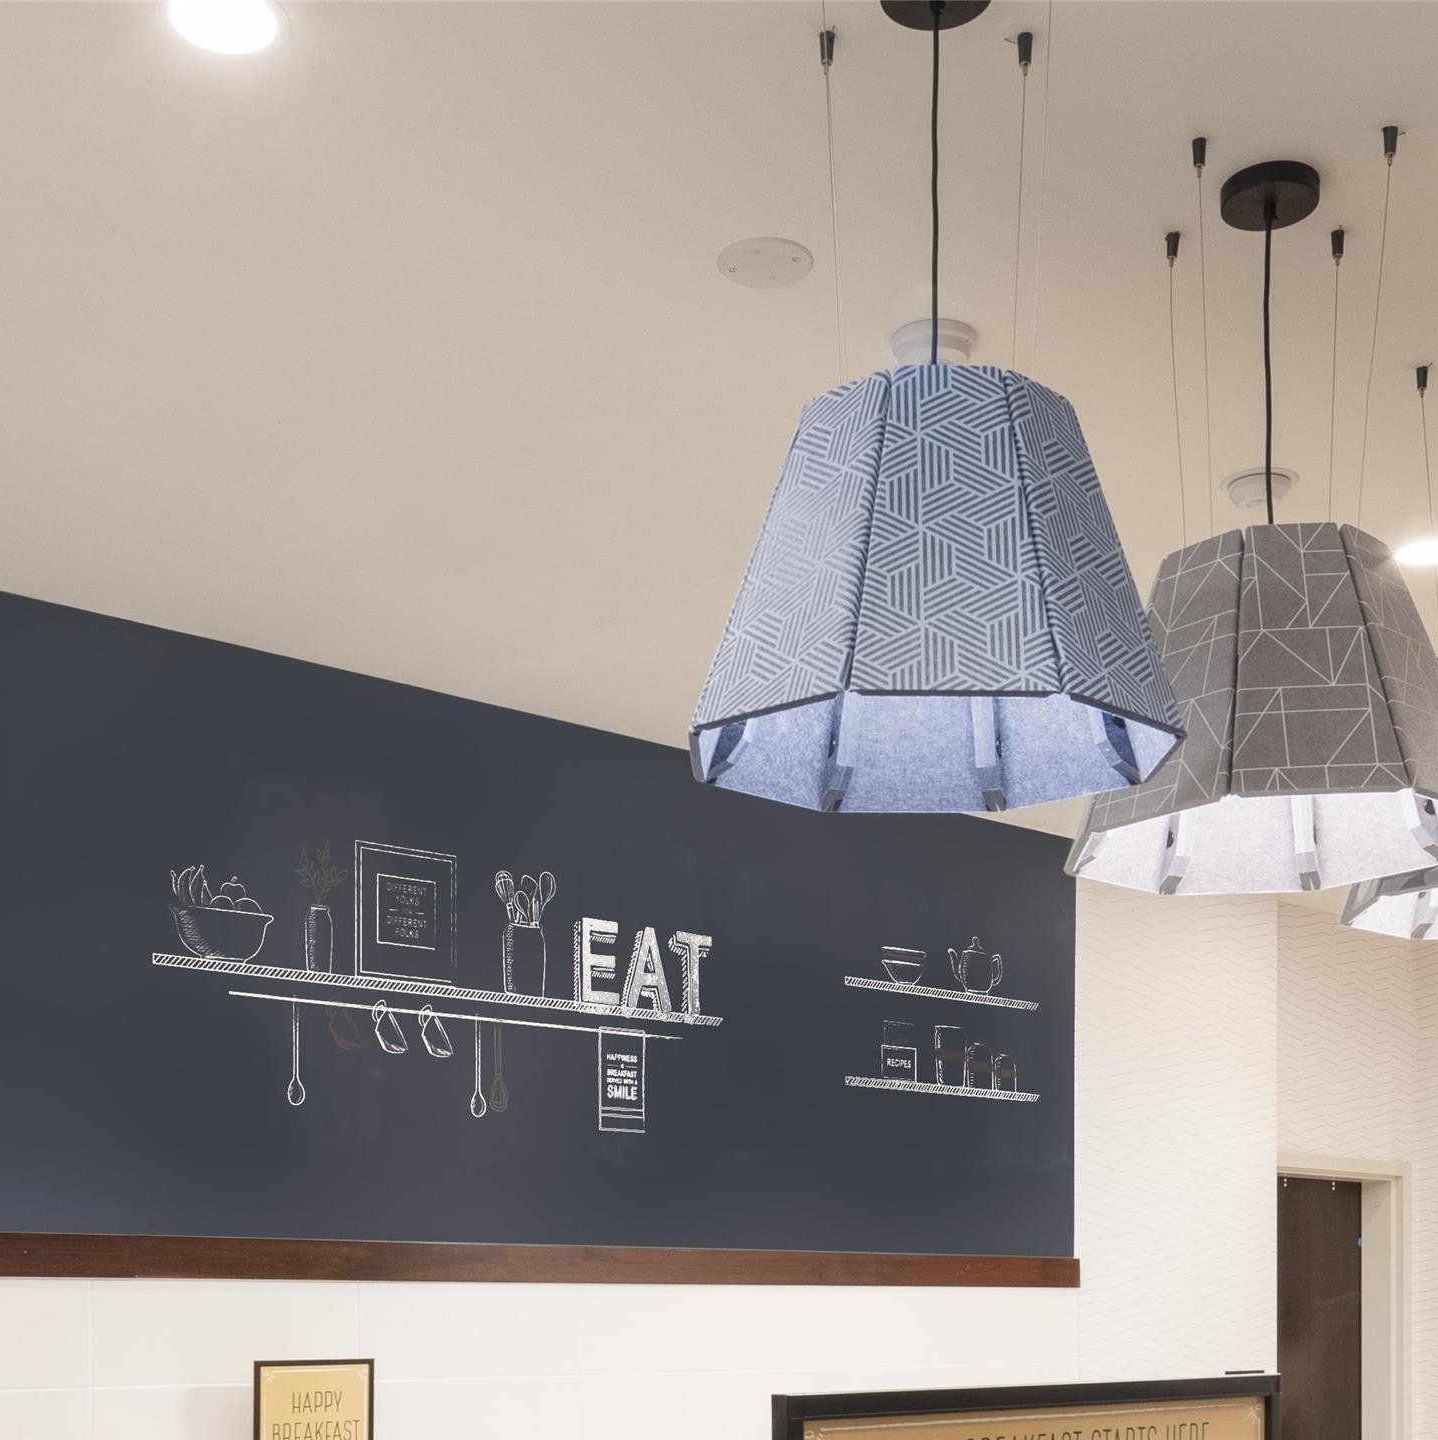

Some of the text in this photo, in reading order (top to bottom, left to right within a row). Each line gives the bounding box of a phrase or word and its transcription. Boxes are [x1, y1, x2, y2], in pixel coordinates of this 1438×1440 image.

[574, 917, 712, 1016] EAT
[886, 1058, 912, 1069] RECIPES
[606, 1069, 637, 1078] BREAKFAST
[606, 1085, 638, 1101] SMILE
[291, 1391, 343, 1414] HAPPY
